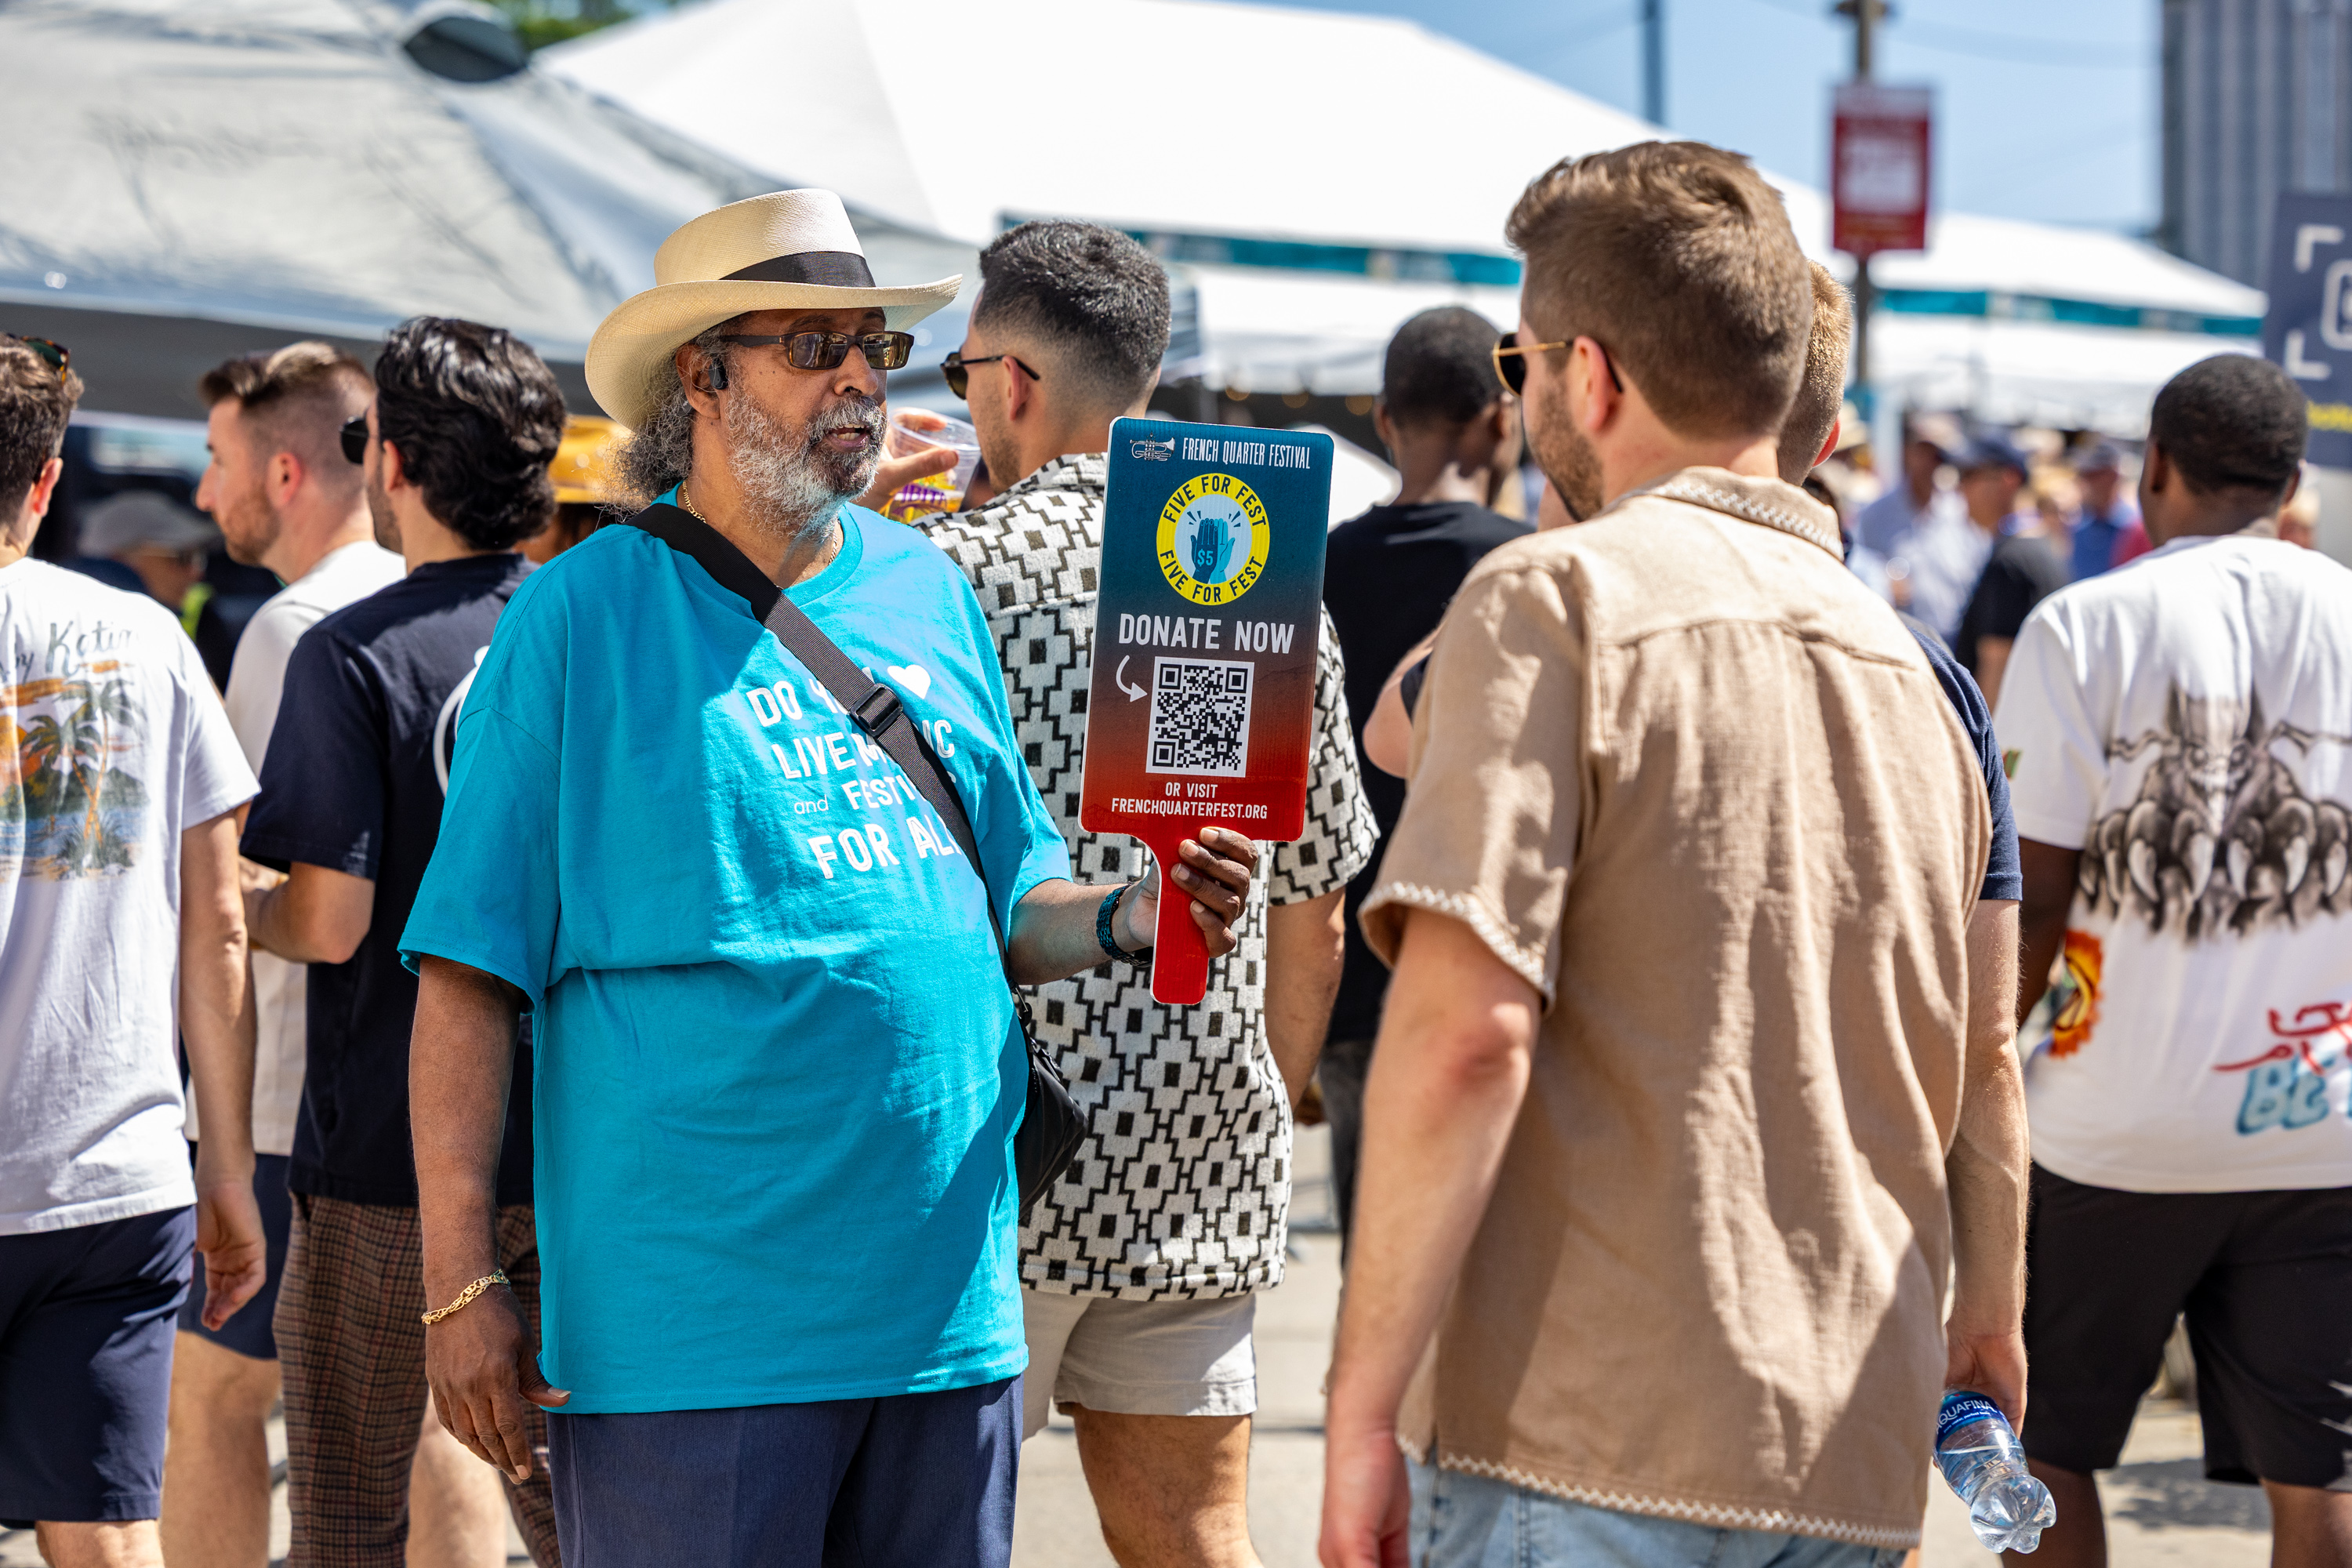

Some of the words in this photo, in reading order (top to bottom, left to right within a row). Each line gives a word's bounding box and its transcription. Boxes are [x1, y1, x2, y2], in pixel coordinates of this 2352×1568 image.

[1182, 437, 1219, 463] FRENCH
[1222, 441, 1265, 466] QUARTER
[1269, 443, 1311, 470] FESTIVAL
[1163, 484, 1196, 524] FIVE
[1201, 475, 1231, 494] FOR
[1235, 485, 1266, 527] FEST
[1160, 550, 1189, 591] FIVE
[1192, 583, 1221, 603] FOR
[1229, 556, 1264, 597] FEST
[1197, 550, 1214, 567] $5
[1118, 613, 1221, 650] DONATE
[1234, 620, 1294, 655] NOW
[746, 681, 804, 728] DO
[771, 731, 856, 779] LIVE
[851, 719, 956, 768] MIC
[793, 795, 829, 815] and
[1111, 798, 1268, 819] FRENCHQUARTERFEST.ORG
[1165, 782, 1181, 797] OR
[1186, 782, 1218, 798] VISIT
[807, 823, 901, 880] FOR
